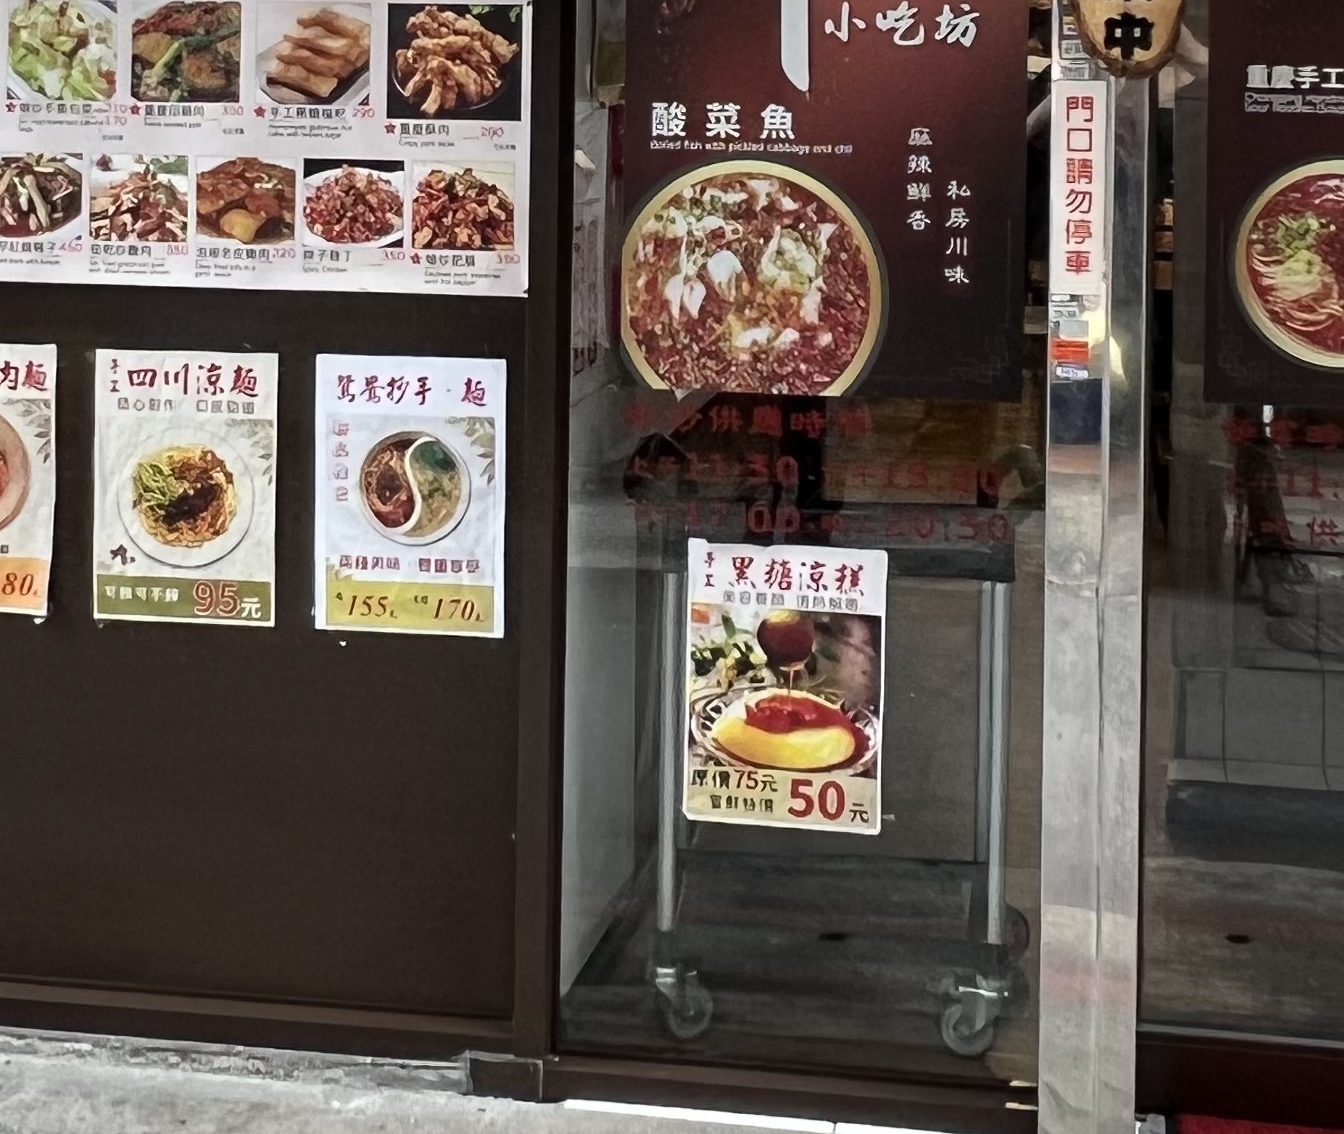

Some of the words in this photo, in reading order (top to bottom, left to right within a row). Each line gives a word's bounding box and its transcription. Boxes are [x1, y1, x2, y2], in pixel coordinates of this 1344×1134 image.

[824, 0, 981, 49] 小吃坊
[651, 101, 797, 141] 酸菜魚
[1064, 94, 1095, 276] 門口請勿停車
[127, 362, 261, 399] 四川涼麵
[727, 555, 866, 597] 黑糖涼糕
